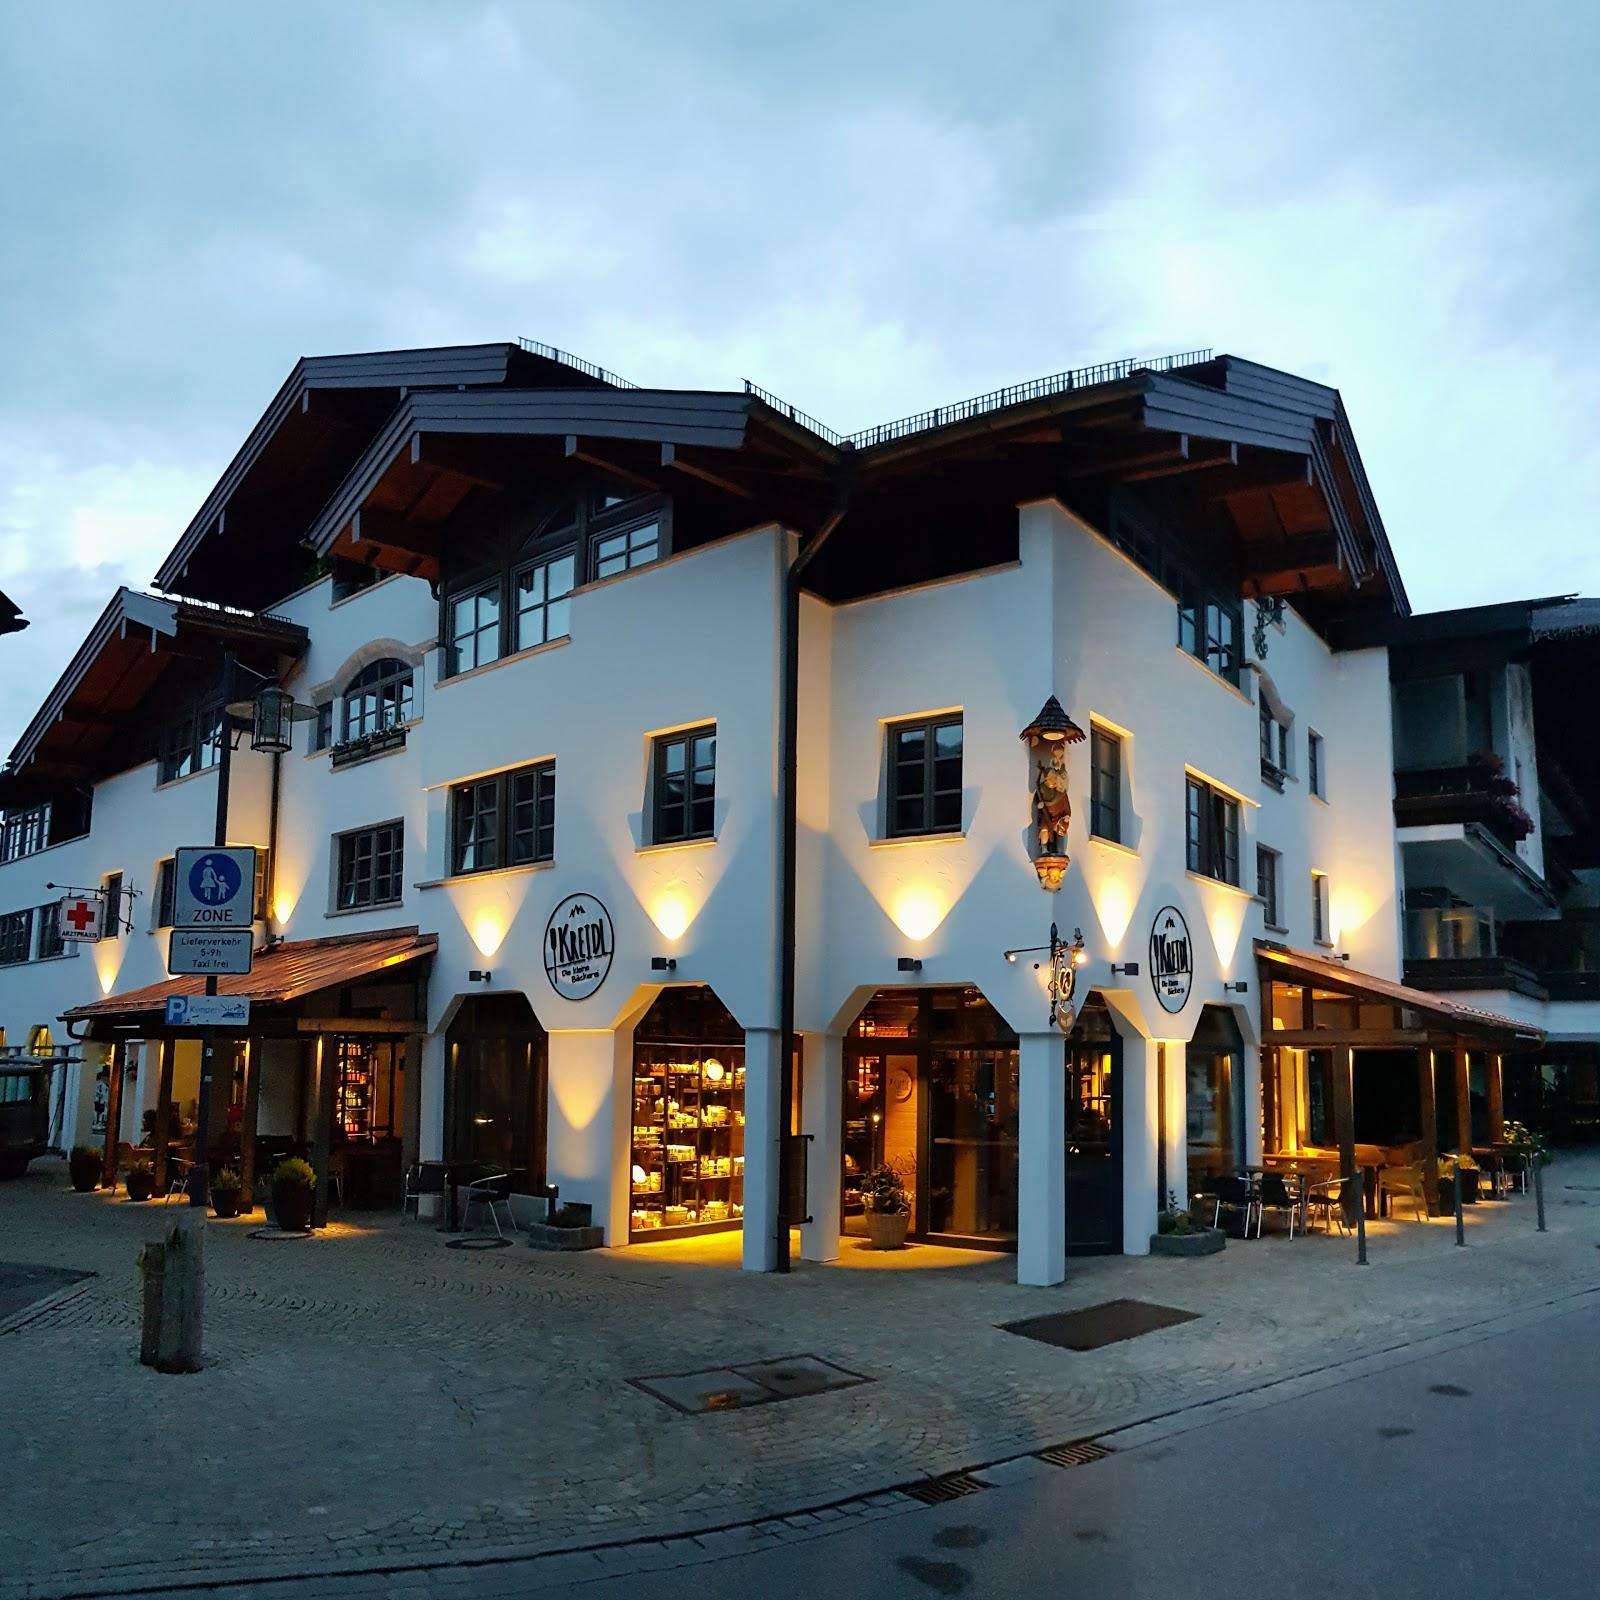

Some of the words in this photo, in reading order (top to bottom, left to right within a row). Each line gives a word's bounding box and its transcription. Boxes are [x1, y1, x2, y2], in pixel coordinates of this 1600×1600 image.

[193, 909, 233, 922] ZONE
[181, 937, 241, 946] Lieferverkehr
[192, 959, 210, 968] Taxi
[213, 959, 229, 968] frei
[168, 998, 186, 1021] P
